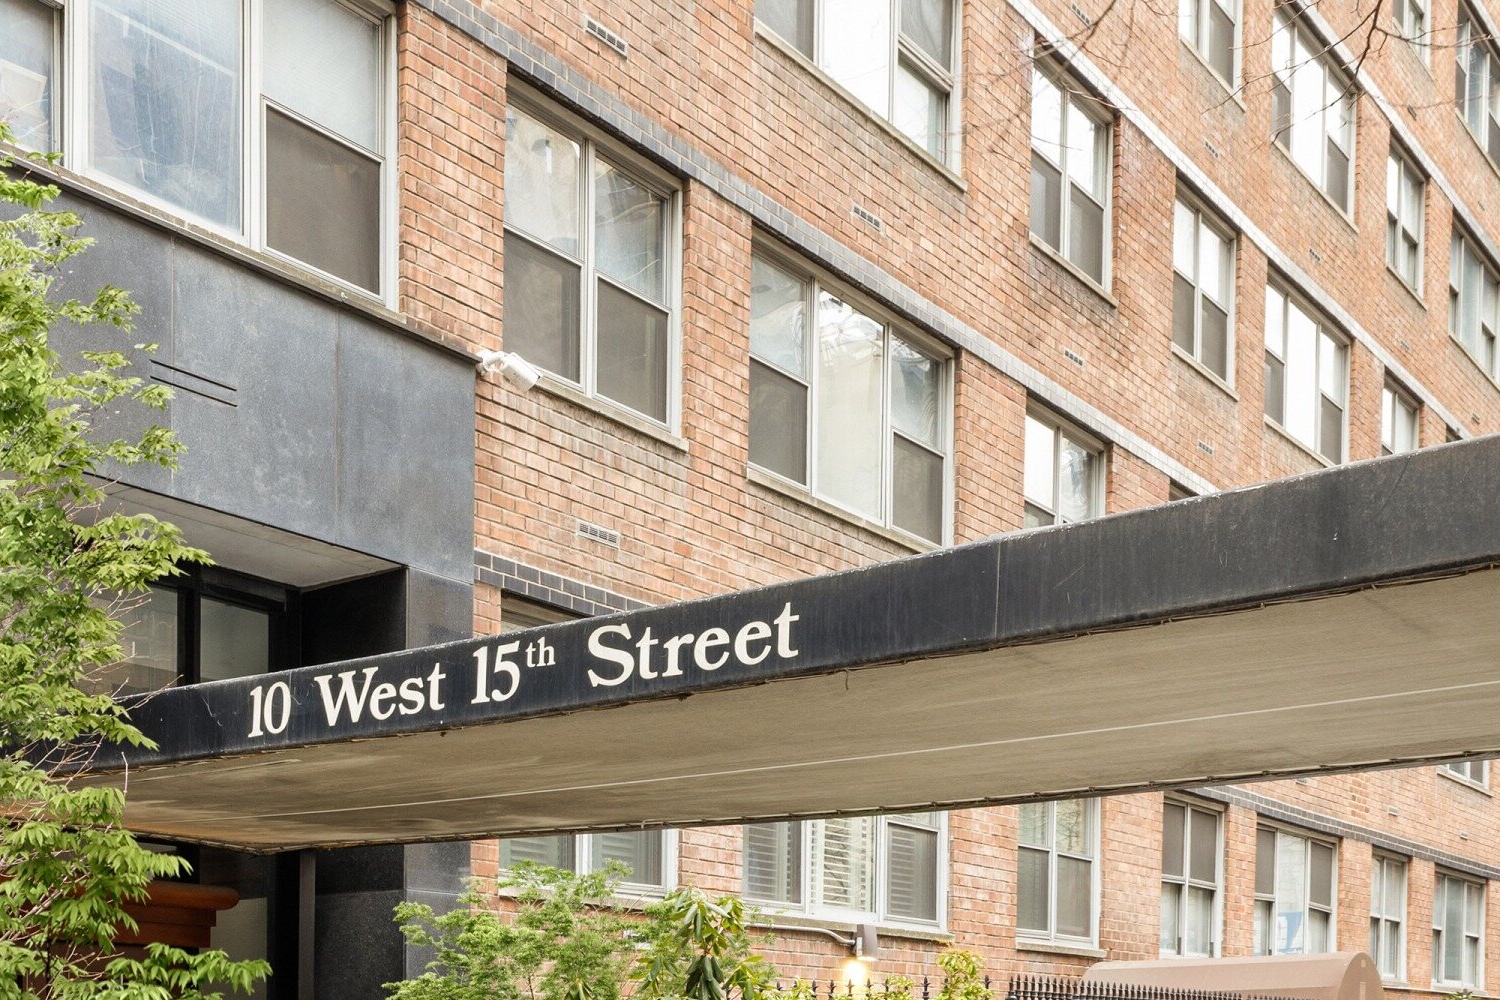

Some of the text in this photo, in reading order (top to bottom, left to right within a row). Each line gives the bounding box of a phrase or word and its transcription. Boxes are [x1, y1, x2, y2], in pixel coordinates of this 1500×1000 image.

[247, 601, 800, 738] 10 West 15th Street
